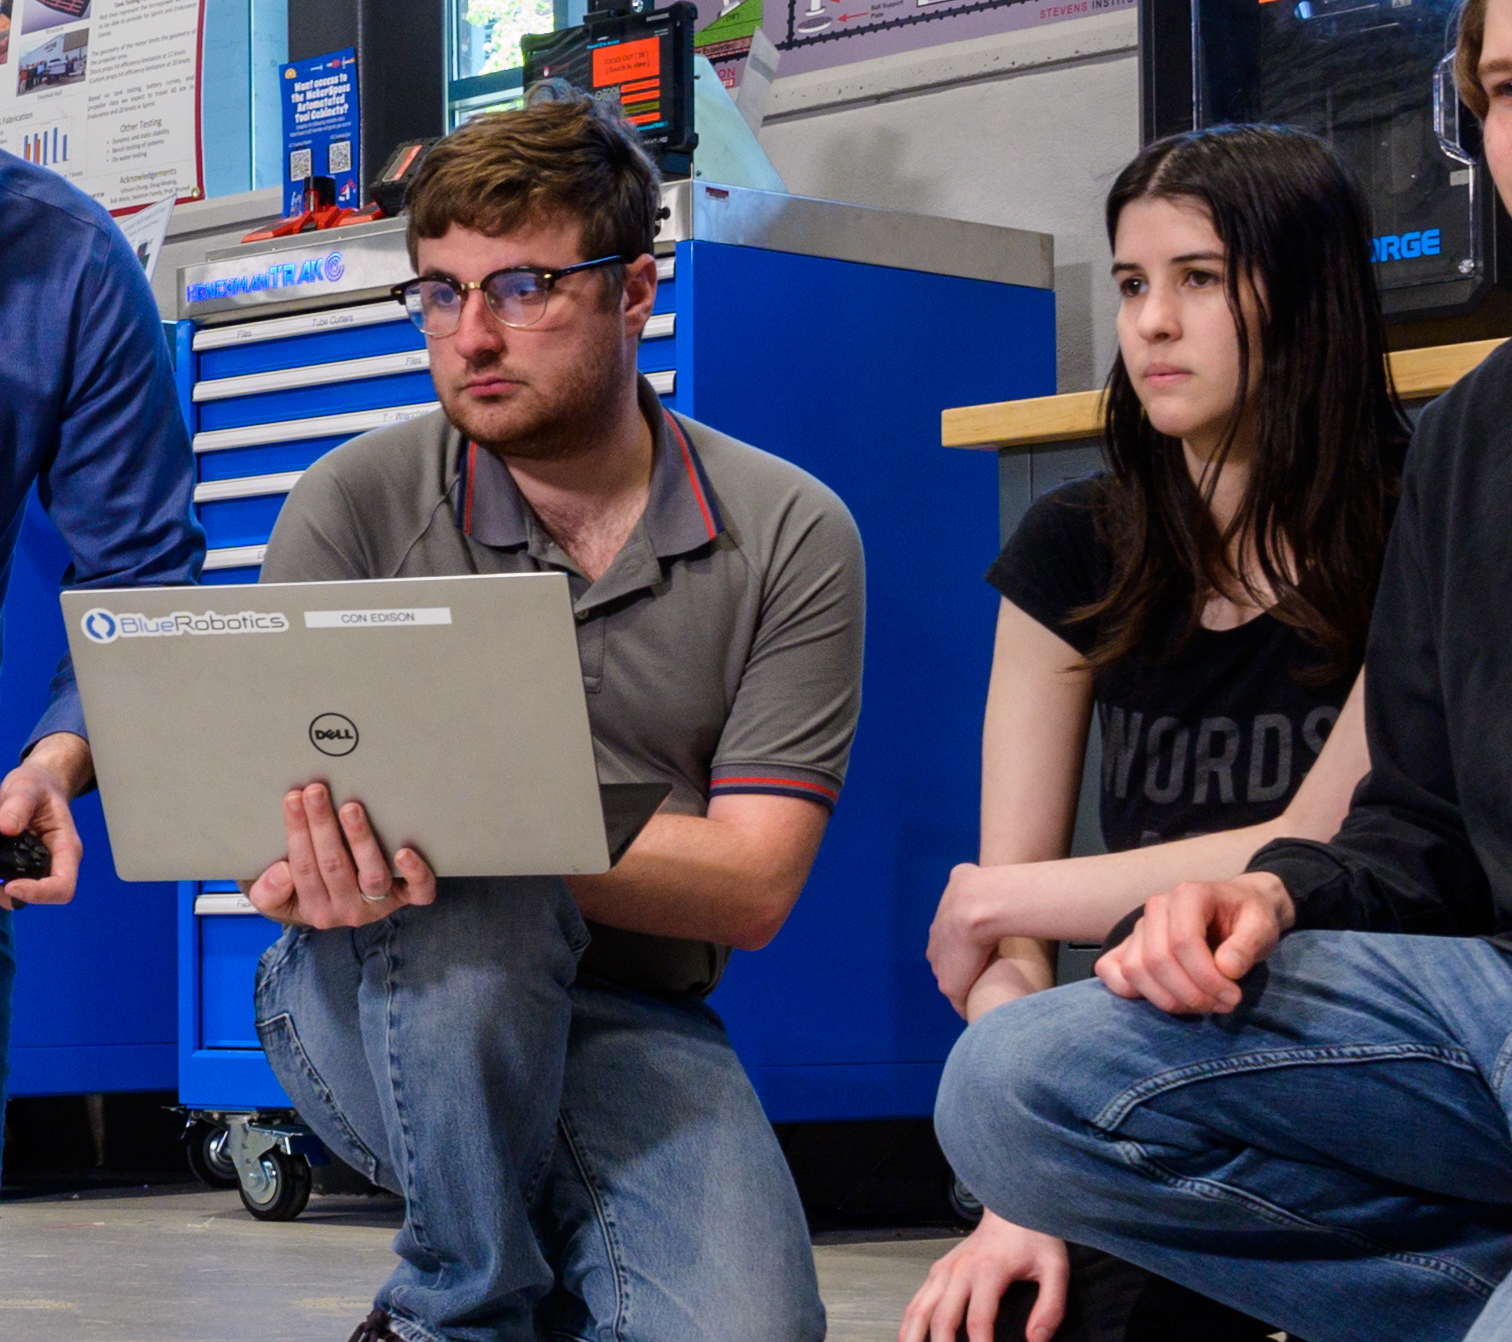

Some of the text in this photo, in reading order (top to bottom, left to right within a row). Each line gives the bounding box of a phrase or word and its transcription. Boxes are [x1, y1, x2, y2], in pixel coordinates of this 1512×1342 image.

[1040, 1, 1087, 18] STEVENS
[294, 73, 348, 93] Want access to
[295, 103, 349, 124] Tool Cabinets?
[120, 118, 162, 133] Other Testing
[120, 168, 176, 183] Acknowledgements
[312, 317, 329, 327] Tube
[236, 329, 252, 339] Files
[405, 356, 422, 366] Files
[120, 614, 285, 635] BlueRobotics
[341, 612, 415, 624] CON EDISON
[314, 729, 354, 741] DELL
